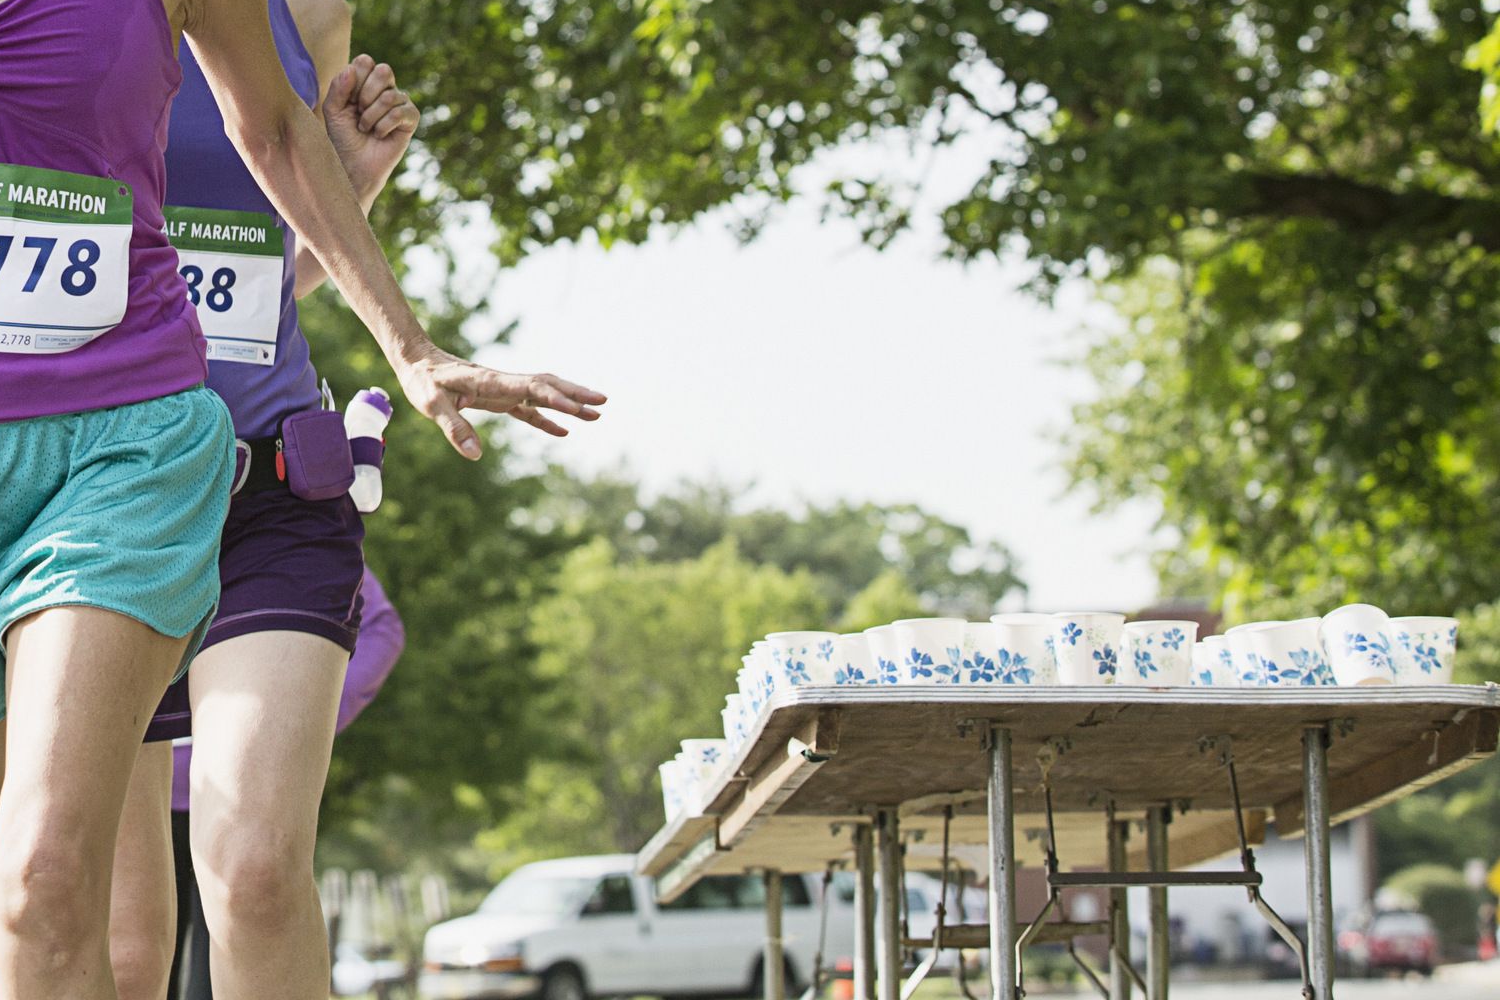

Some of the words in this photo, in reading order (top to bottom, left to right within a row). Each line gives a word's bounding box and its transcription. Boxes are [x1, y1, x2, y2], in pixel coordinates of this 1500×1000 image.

[7, 183, 107, 215] MARATHON
[160, 220, 187, 238] ALF
[190, 222, 266, 244] MARATHON
[178, 264, 237, 313] 88
[0, 332, 32, 347] 2,778
